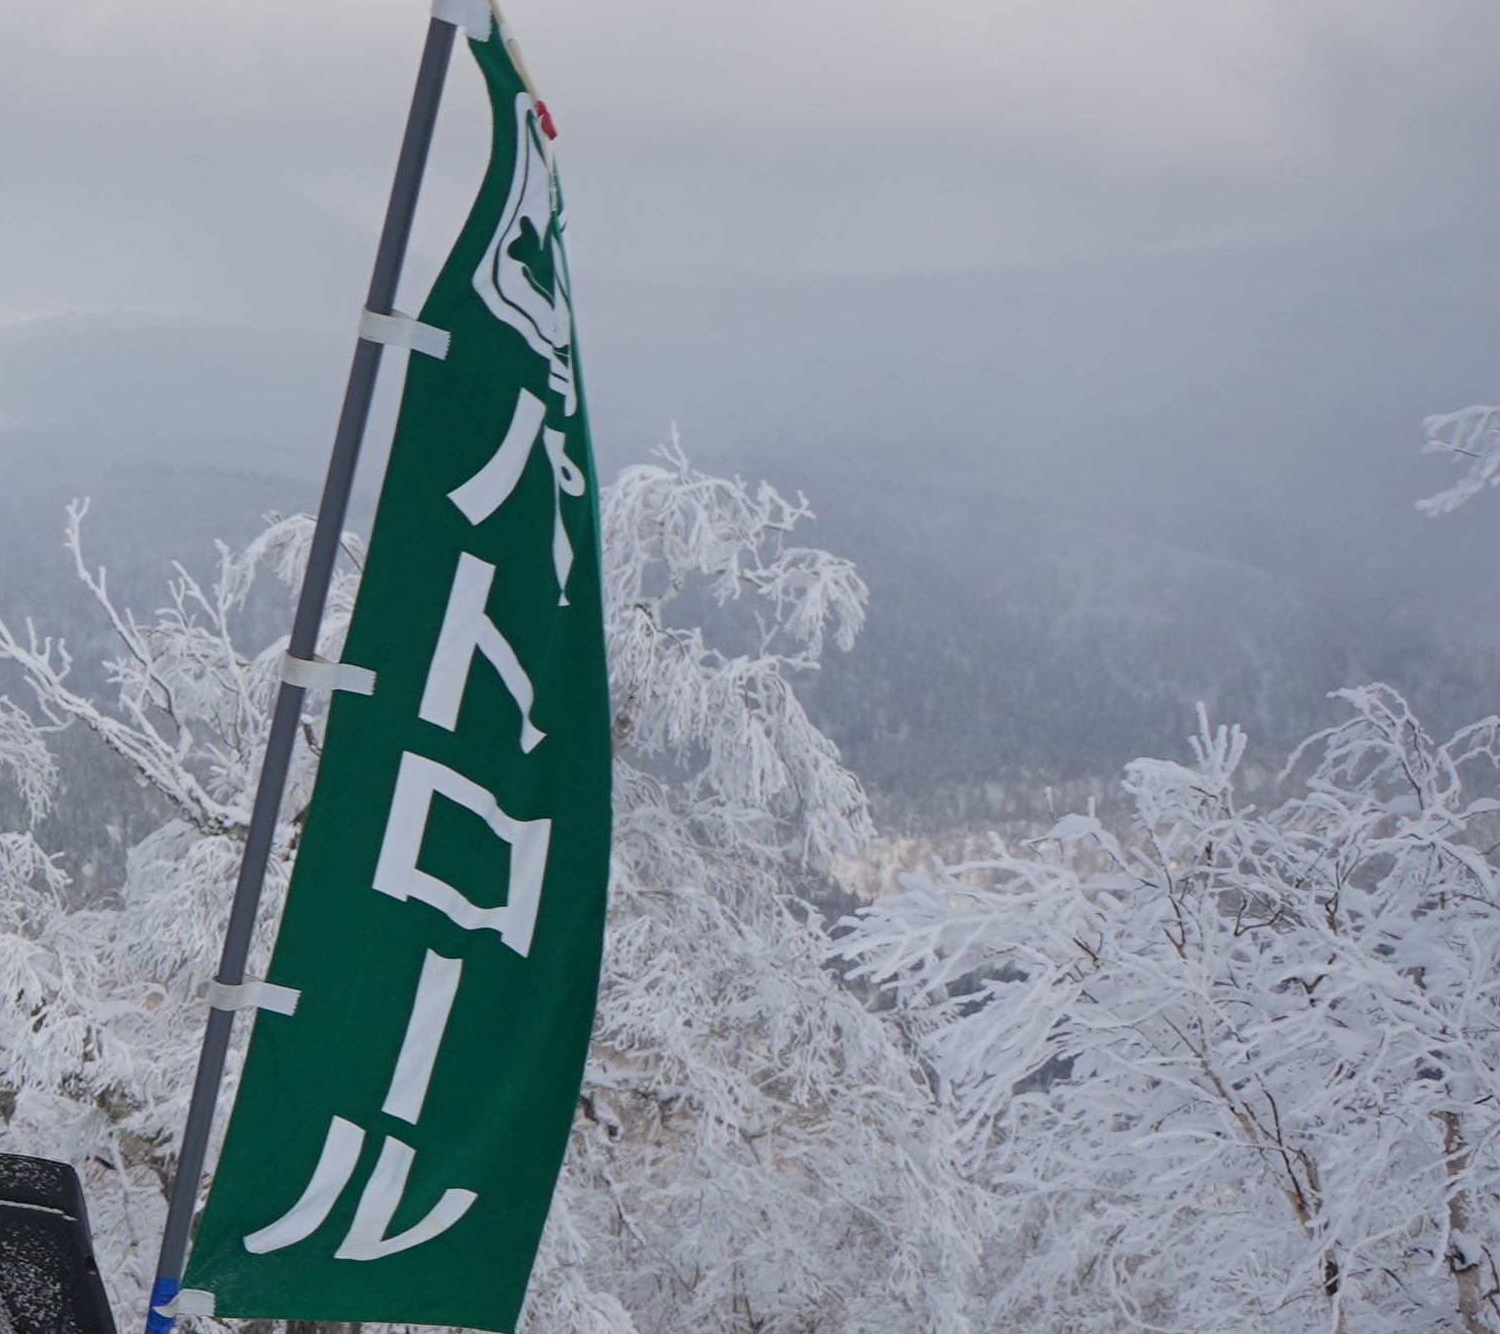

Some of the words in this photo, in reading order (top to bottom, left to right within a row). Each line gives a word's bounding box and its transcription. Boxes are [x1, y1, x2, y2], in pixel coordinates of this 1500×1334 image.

[243, 385, 586, 1262] パトロール
